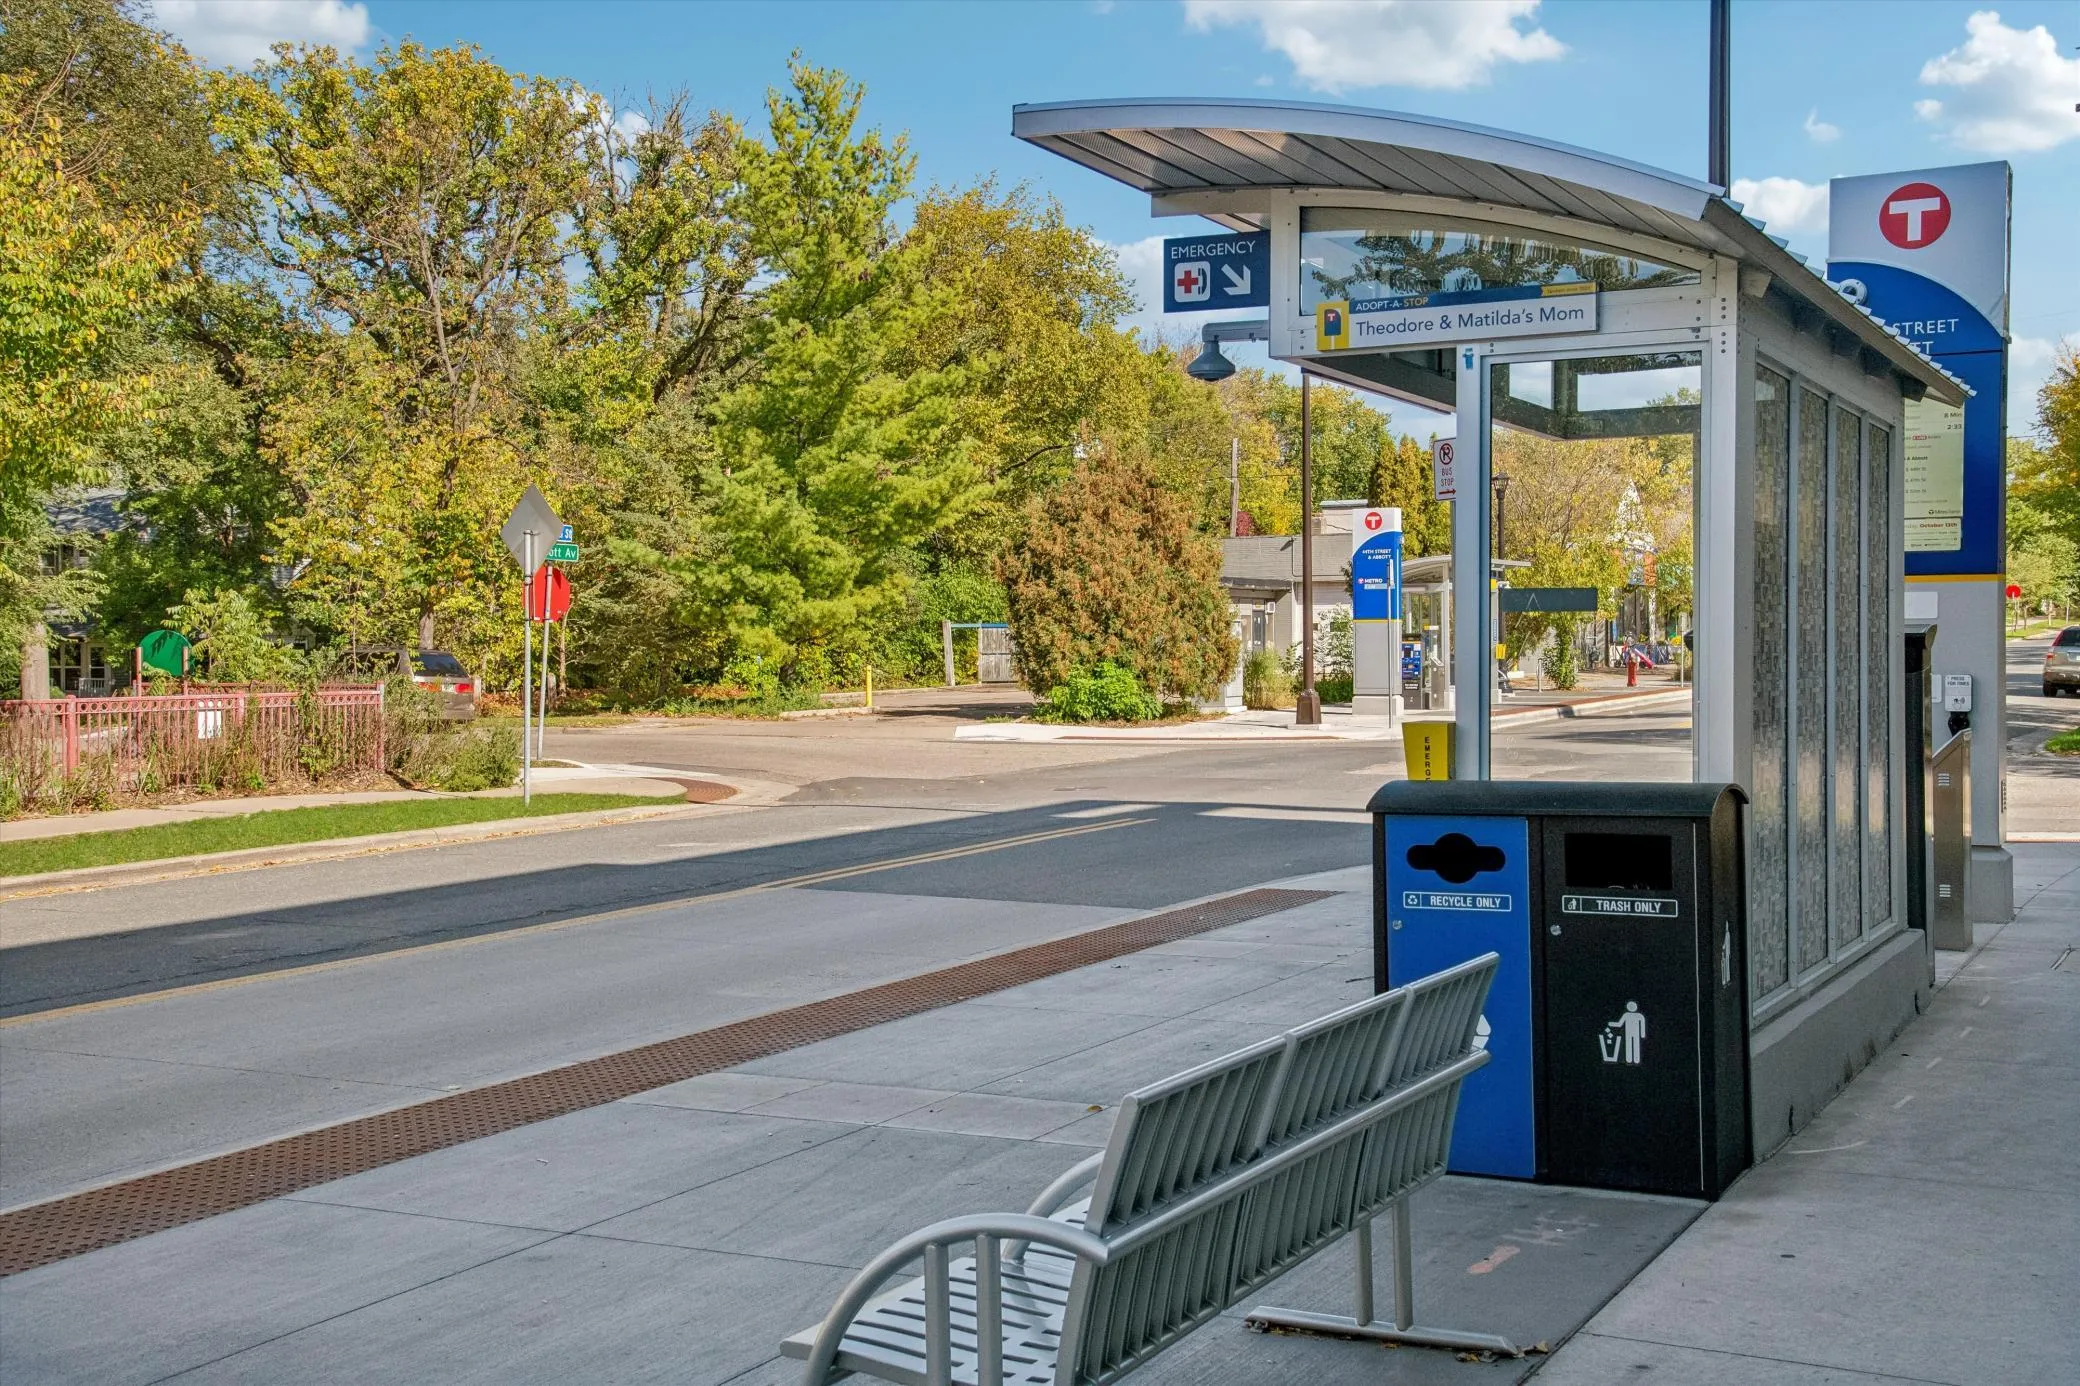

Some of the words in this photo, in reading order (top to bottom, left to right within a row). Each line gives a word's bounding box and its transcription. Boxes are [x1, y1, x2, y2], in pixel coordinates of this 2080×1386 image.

[1889, 197, 1941, 242] T
[1171, 240, 1256, 259] EMERGENCY
[1355, 297, 1429, 312] ADOPT-A-STOP
[1355, 318, 1434, 337] Theodore
[1440, 314, 1452, 330] &
[1458, 308, 1533, 329] Matilda's
[1539, 306, 1584, 322] Mom
[1366, 515, 1380, 529] T
[549, 547, 561, 558] ott
[565, 547, 577, 558] Av
[1430, 895, 1472, 907] RECYCLE
[1476, 897, 1501, 908] ONLY
[1596, 900, 1631, 912] TRASH
[1634, 901, 1662, 913] ONLY
